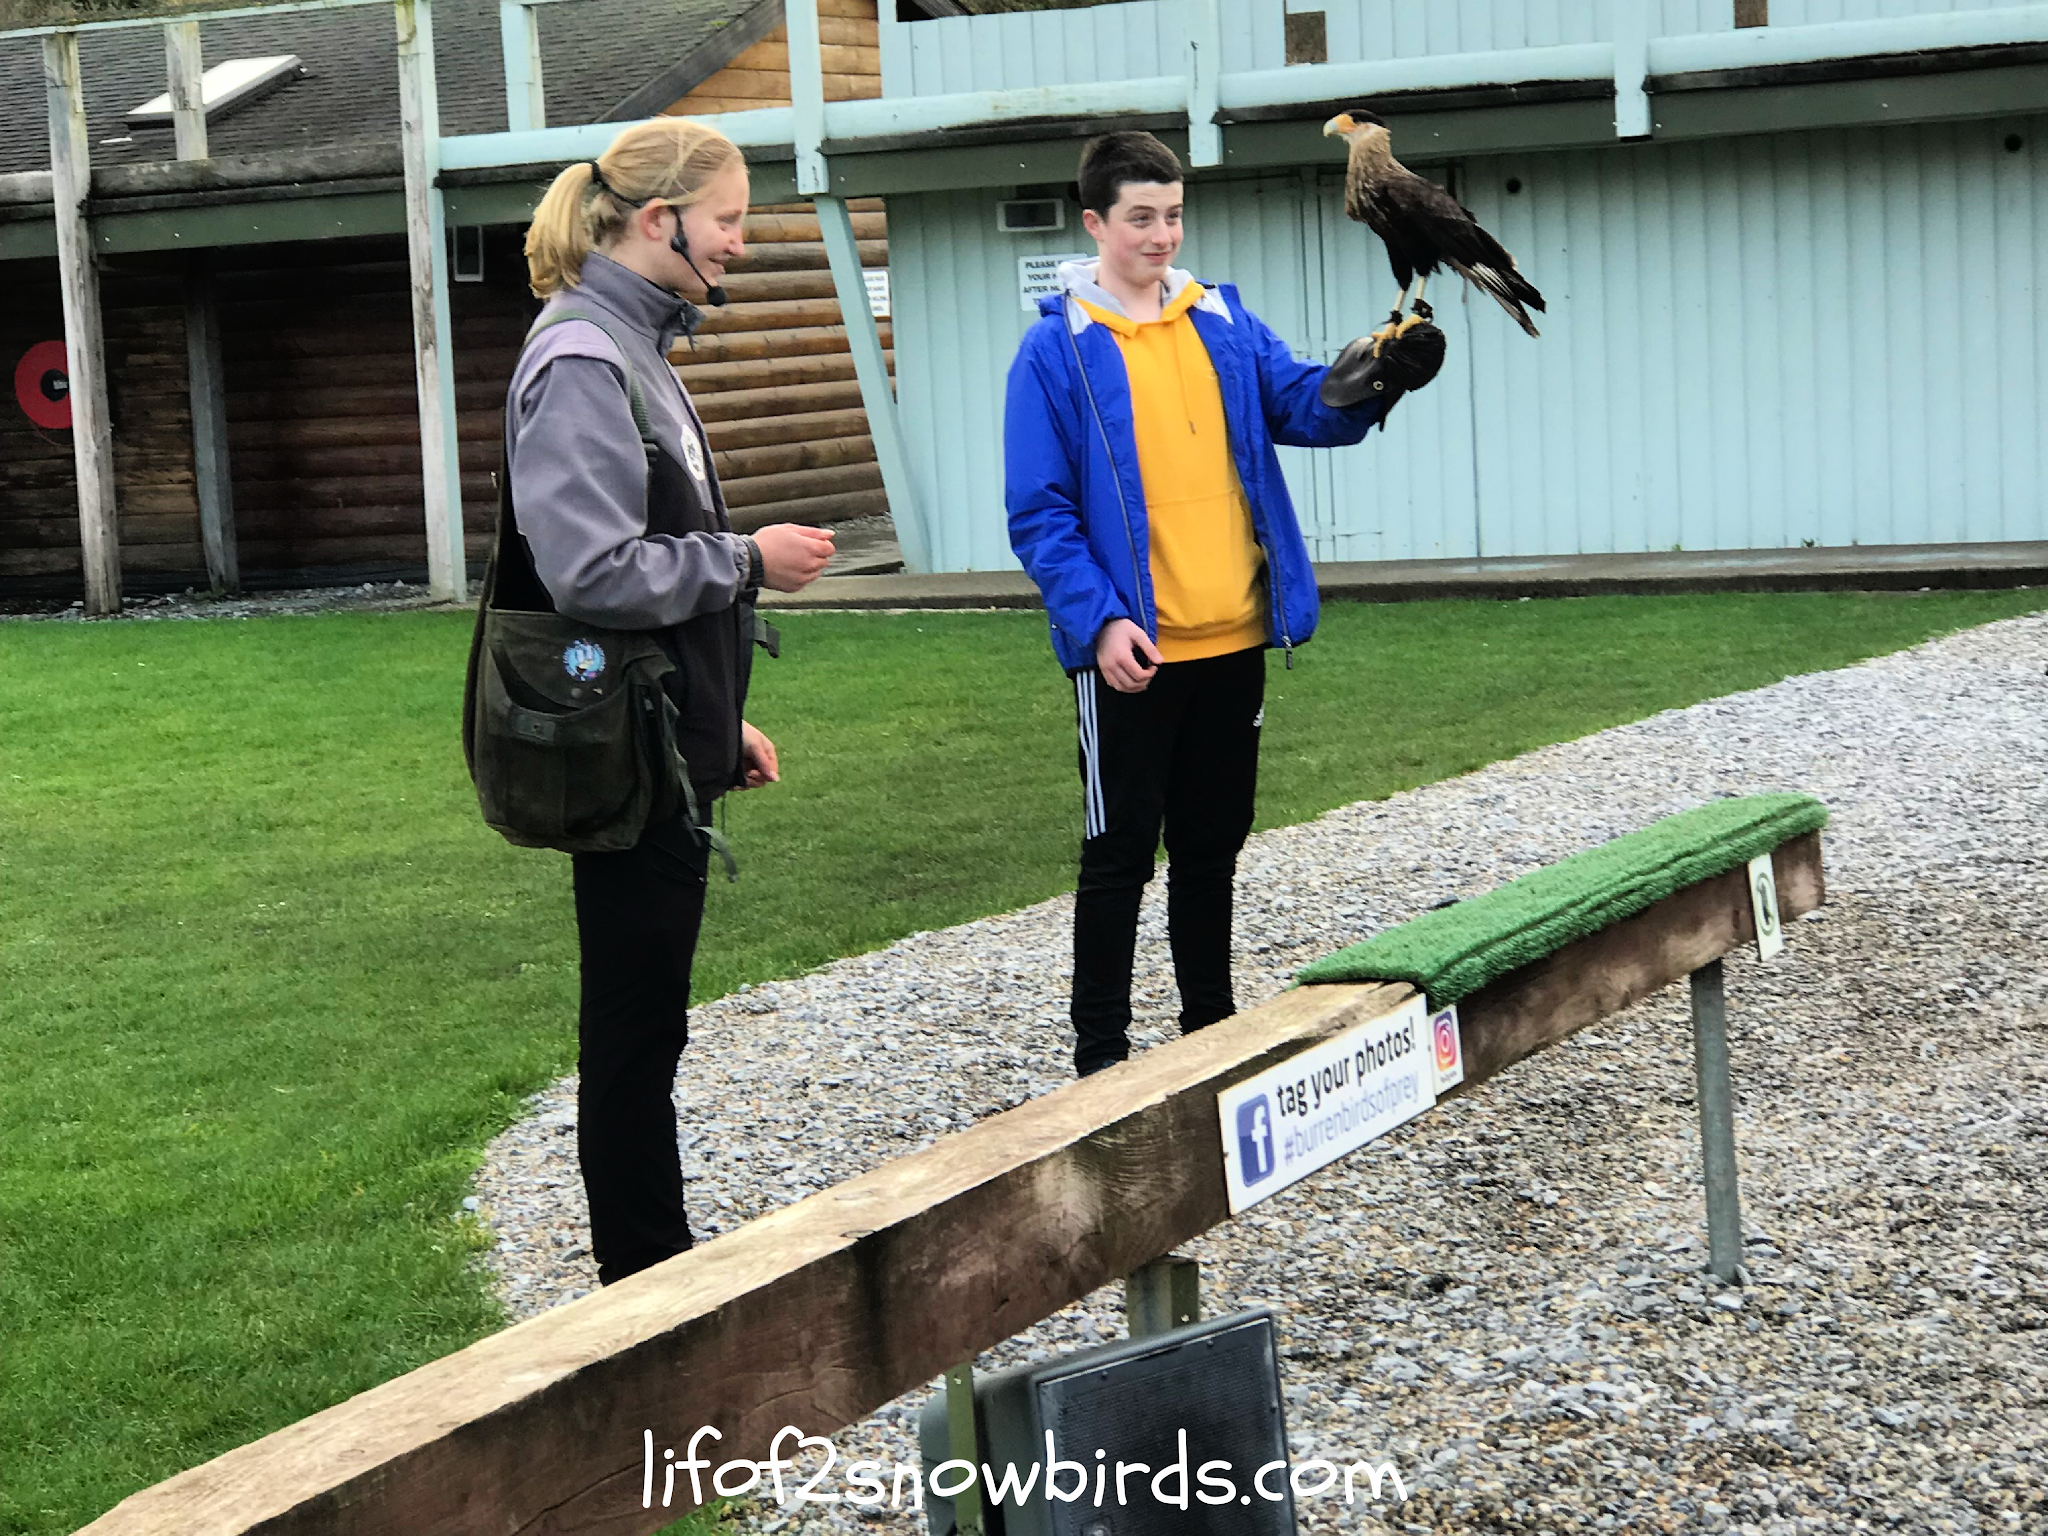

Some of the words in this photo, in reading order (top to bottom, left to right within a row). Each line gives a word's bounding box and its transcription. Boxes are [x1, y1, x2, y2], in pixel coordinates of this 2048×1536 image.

[1025, 260, 1055, 268] PLEASE
[1027, 273, 1051, 281] YOUR
[1276, 1083, 1308, 1117] tag
[1311, 1056, 1349, 1109] your
[1355, 1016, 1416, 1087] photos!
[1284, 1071, 1419, 1166] #burrenbirdsofprey
